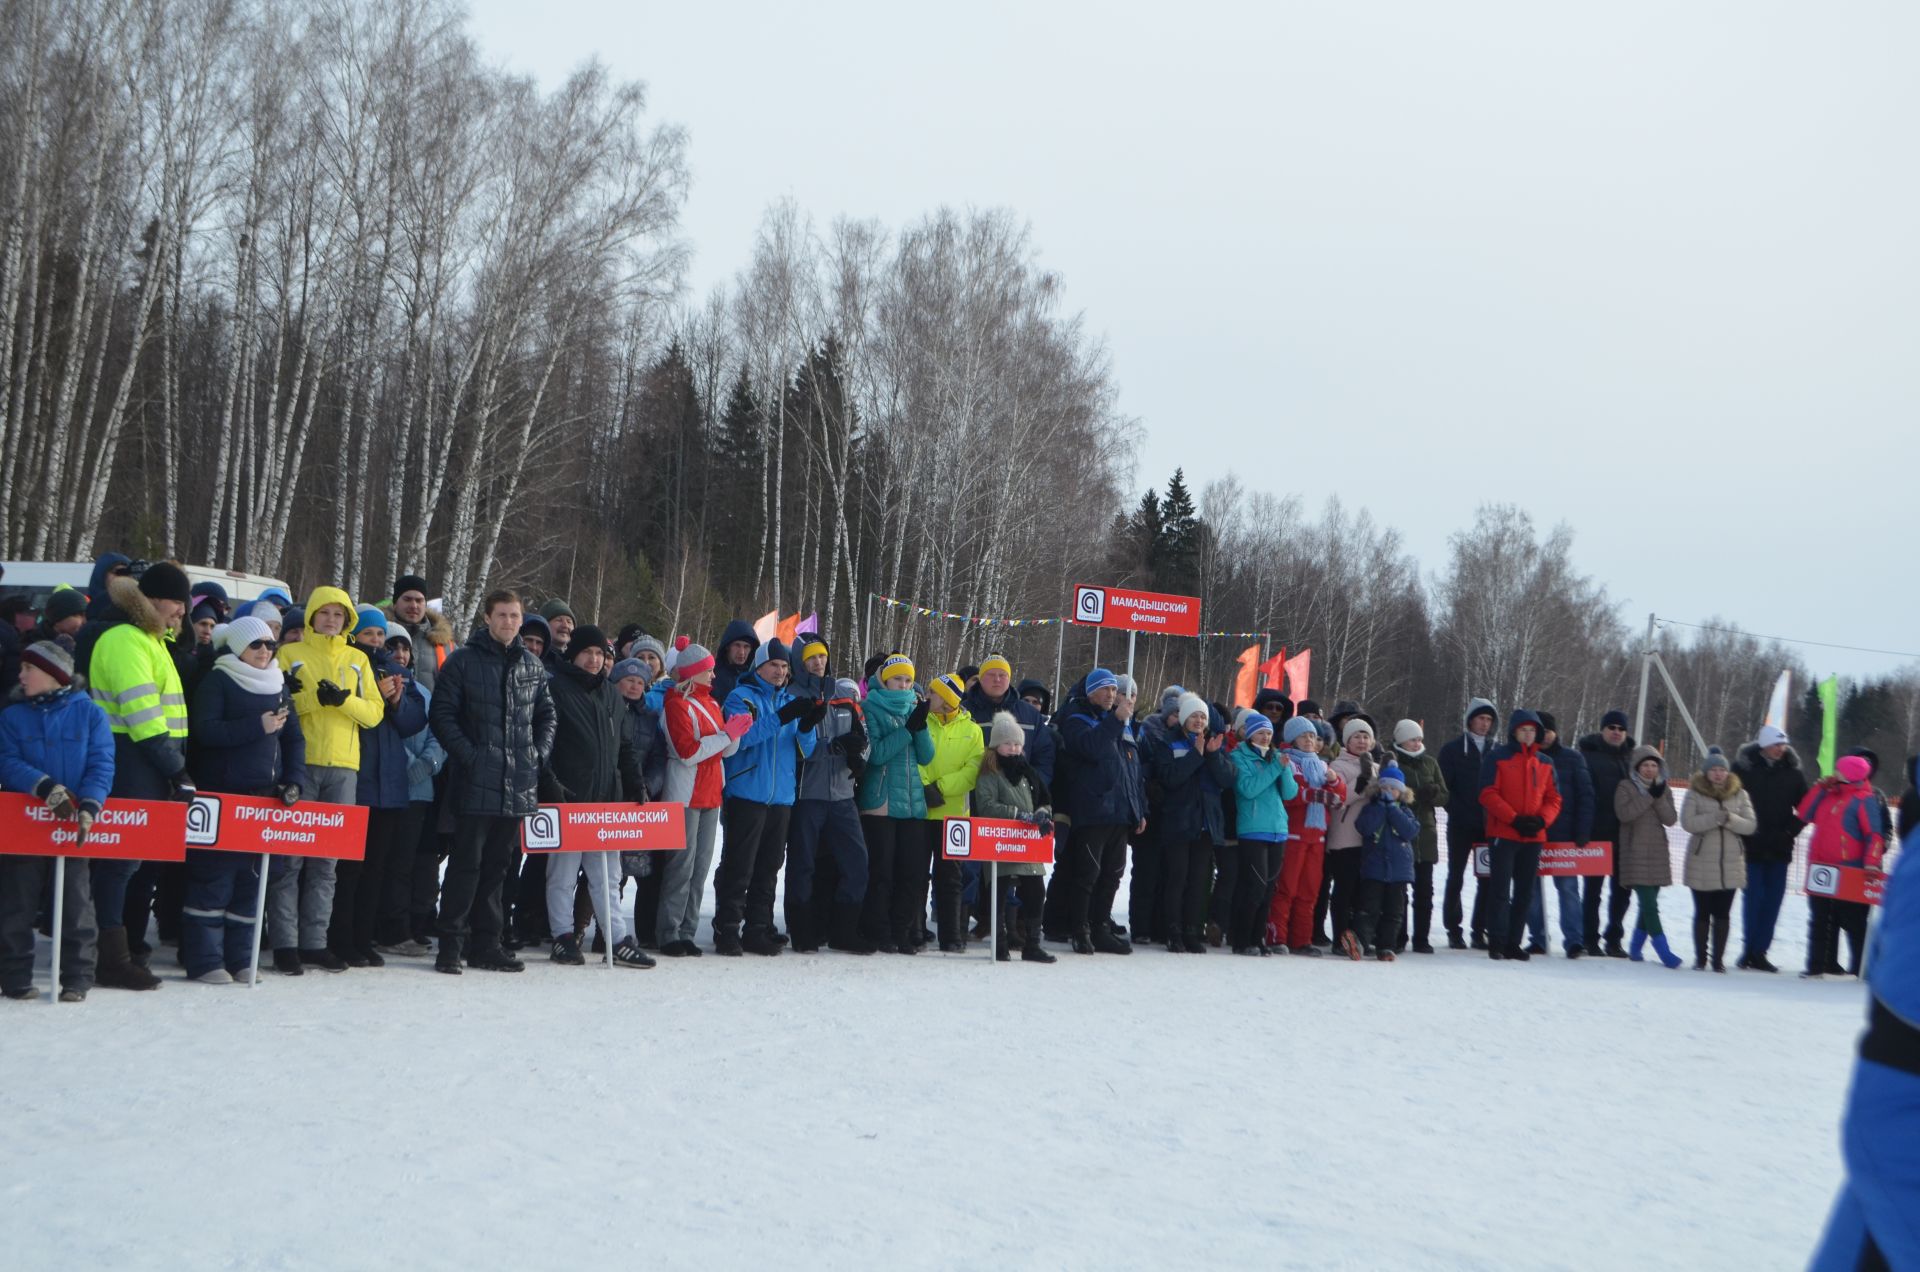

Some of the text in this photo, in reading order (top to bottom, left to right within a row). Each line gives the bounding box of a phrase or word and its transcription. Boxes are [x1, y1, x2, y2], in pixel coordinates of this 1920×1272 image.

[1111, 596, 1188, 613] МАМАДЫШСКИЙ
[1130, 612, 1166, 624] филиал
[25, 805, 148, 826] ЧЕСКИЙ
[235, 805, 345, 827] ПРИГОРОДНЫЙ
[568, 809, 669, 824] НИЖНЕКАМСКИЙ
[261, 827, 316, 843] филиал
[597, 828, 643, 842] филиал
[995, 841, 1026, 853] филиал
